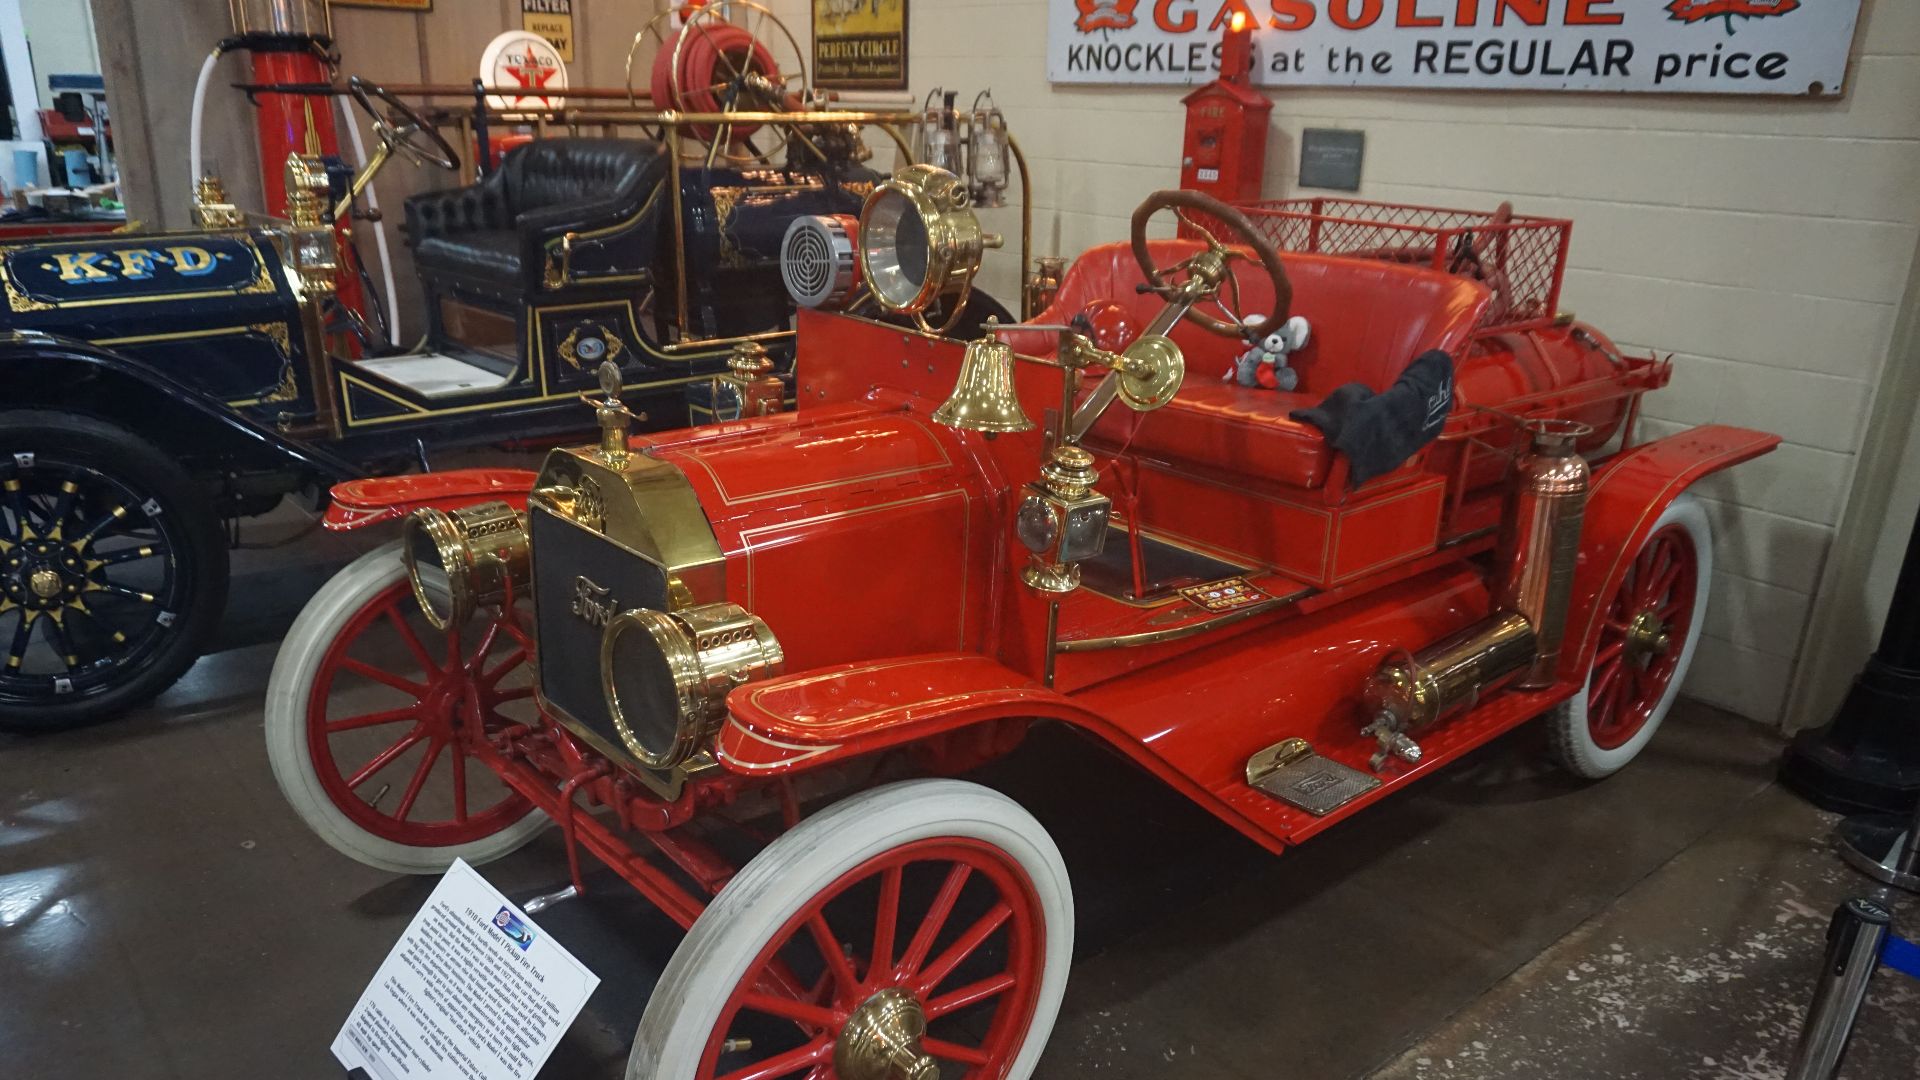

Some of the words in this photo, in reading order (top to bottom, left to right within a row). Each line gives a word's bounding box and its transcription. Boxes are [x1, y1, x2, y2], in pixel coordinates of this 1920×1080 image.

[524, 0, 569, 13] FILTER
[818, 41, 859, 58] PERFECT
[860, 39, 899, 56] CIRCLE
[506, 54, 553, 66] TEXACO
[1271, 48, 1305, 73] at
[1328, 45, 1393, 73] the
[1414, 39, 1635, 77] REGULAR
[1654, 42, 1789, 84] price
[1200, 105, 1226, 118] FIRE
[487, 927, 502, 943] Model
[504, 942, 521, 961] Pickup
[520, 957, 530, 969] Fire
[530, 966, 544, 983] Truck
